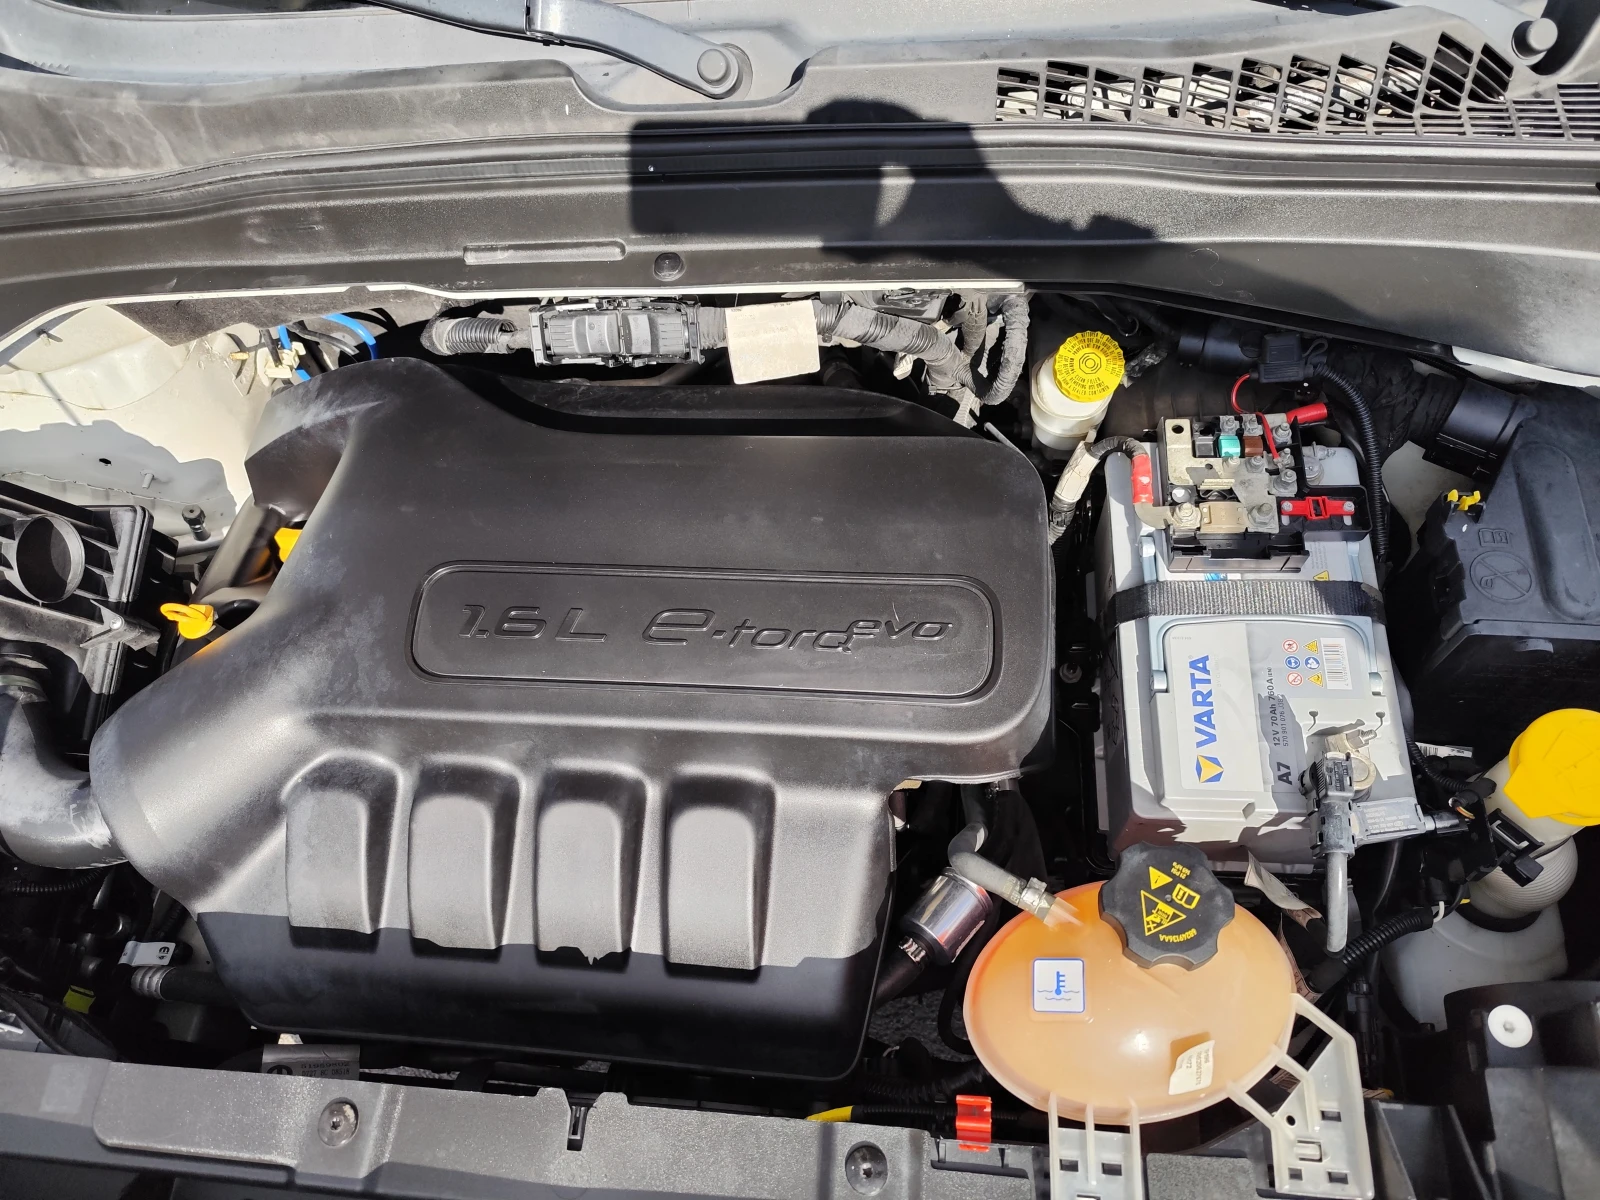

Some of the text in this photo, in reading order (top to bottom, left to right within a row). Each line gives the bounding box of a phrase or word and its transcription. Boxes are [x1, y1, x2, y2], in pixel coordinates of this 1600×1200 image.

[1189, 655, 1217, 748] VARTA
[1270, 703, 1278, 726] 70Ah
[1278, 761, 1292, 786] A7
